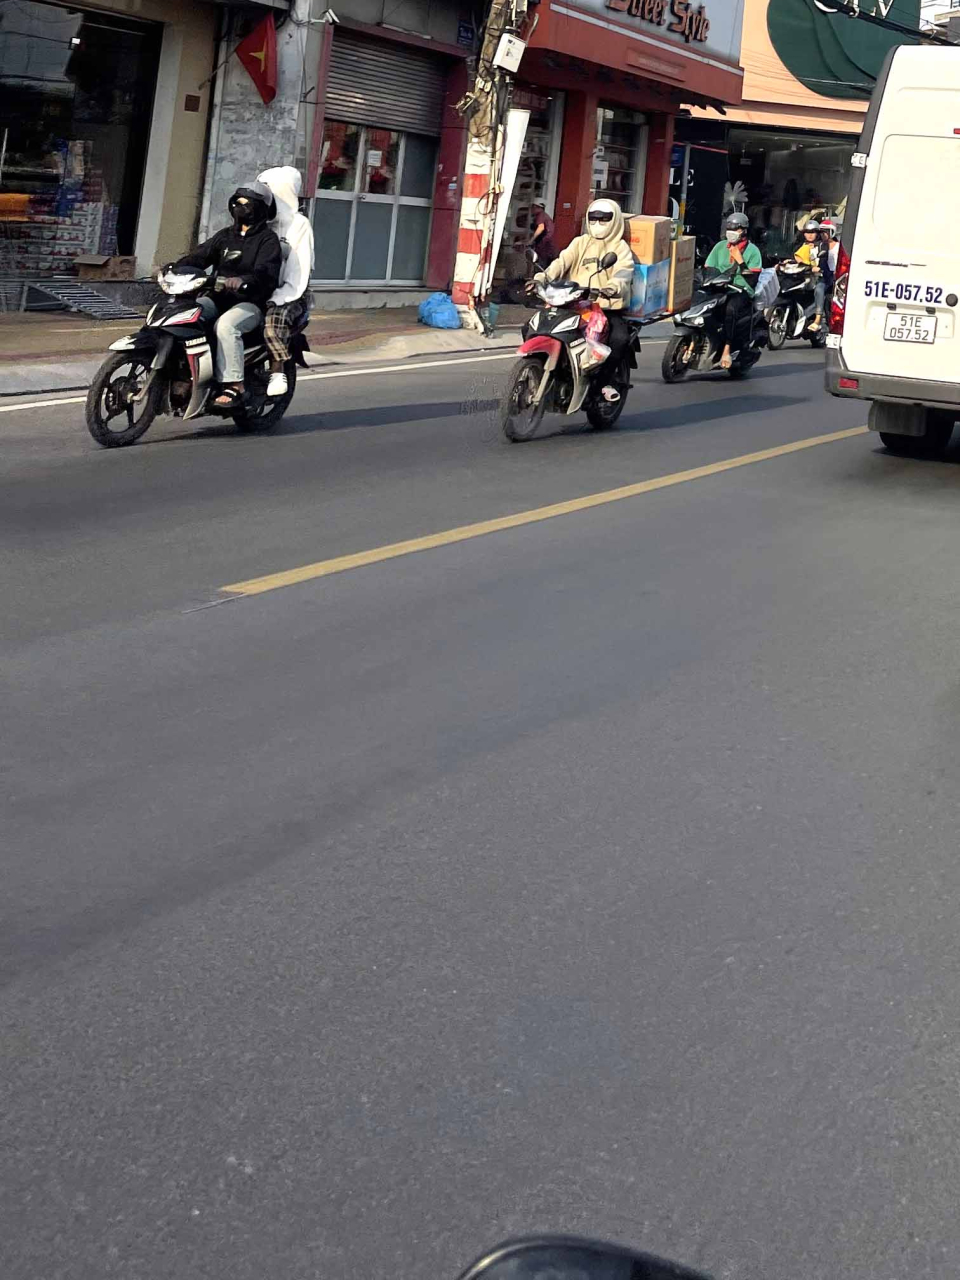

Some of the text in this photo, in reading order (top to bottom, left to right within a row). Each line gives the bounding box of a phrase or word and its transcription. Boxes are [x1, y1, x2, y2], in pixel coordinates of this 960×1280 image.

[864, 280, 943, 304] 51E-057.52
[900, 315, 922, 328] 51E
[889, 327, 929, 341] 057.52
